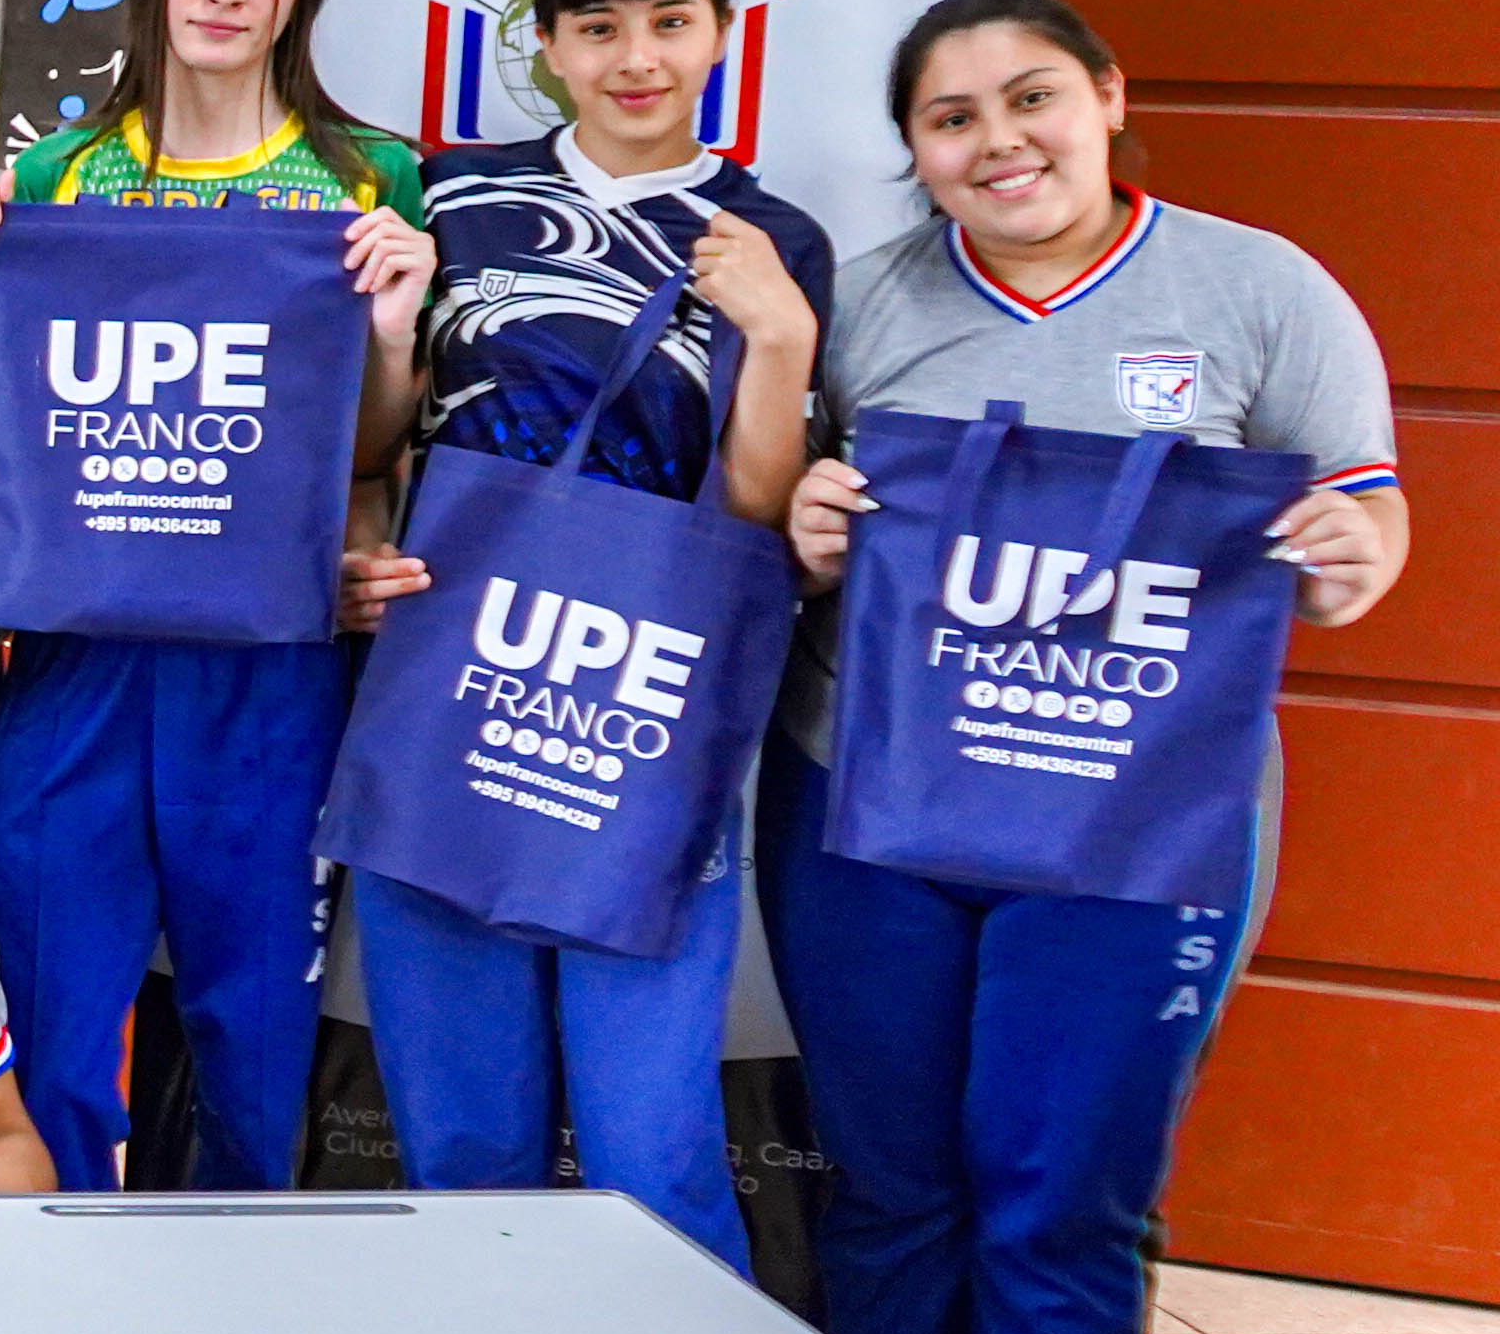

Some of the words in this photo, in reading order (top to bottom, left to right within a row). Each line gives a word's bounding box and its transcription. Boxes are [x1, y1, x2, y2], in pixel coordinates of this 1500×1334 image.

[47, 319, 270, 407] UPE
[47, 408, 262, 455] FRANCO
[75, 490, 233, 510] /upefrancocentral
[85, 516, 126, 533] +595
[129, 515, 221, 535] 994364238
[943, 534, 1201, 652] UPE
[472, 577, 705, 722] UPE
[928, 628, 1180, 699] FRANCO
[454, 665, 671, 760] FRANCO
[952, 715, 1132, 756] /upefrancocentral
[466, 749, 620, 812] /upefrancocentral
[1014, 750, 1117, 781] 994364238
[514, 788, 602, 831] 994364238
[761, 1142, 835, 1170] Caa
